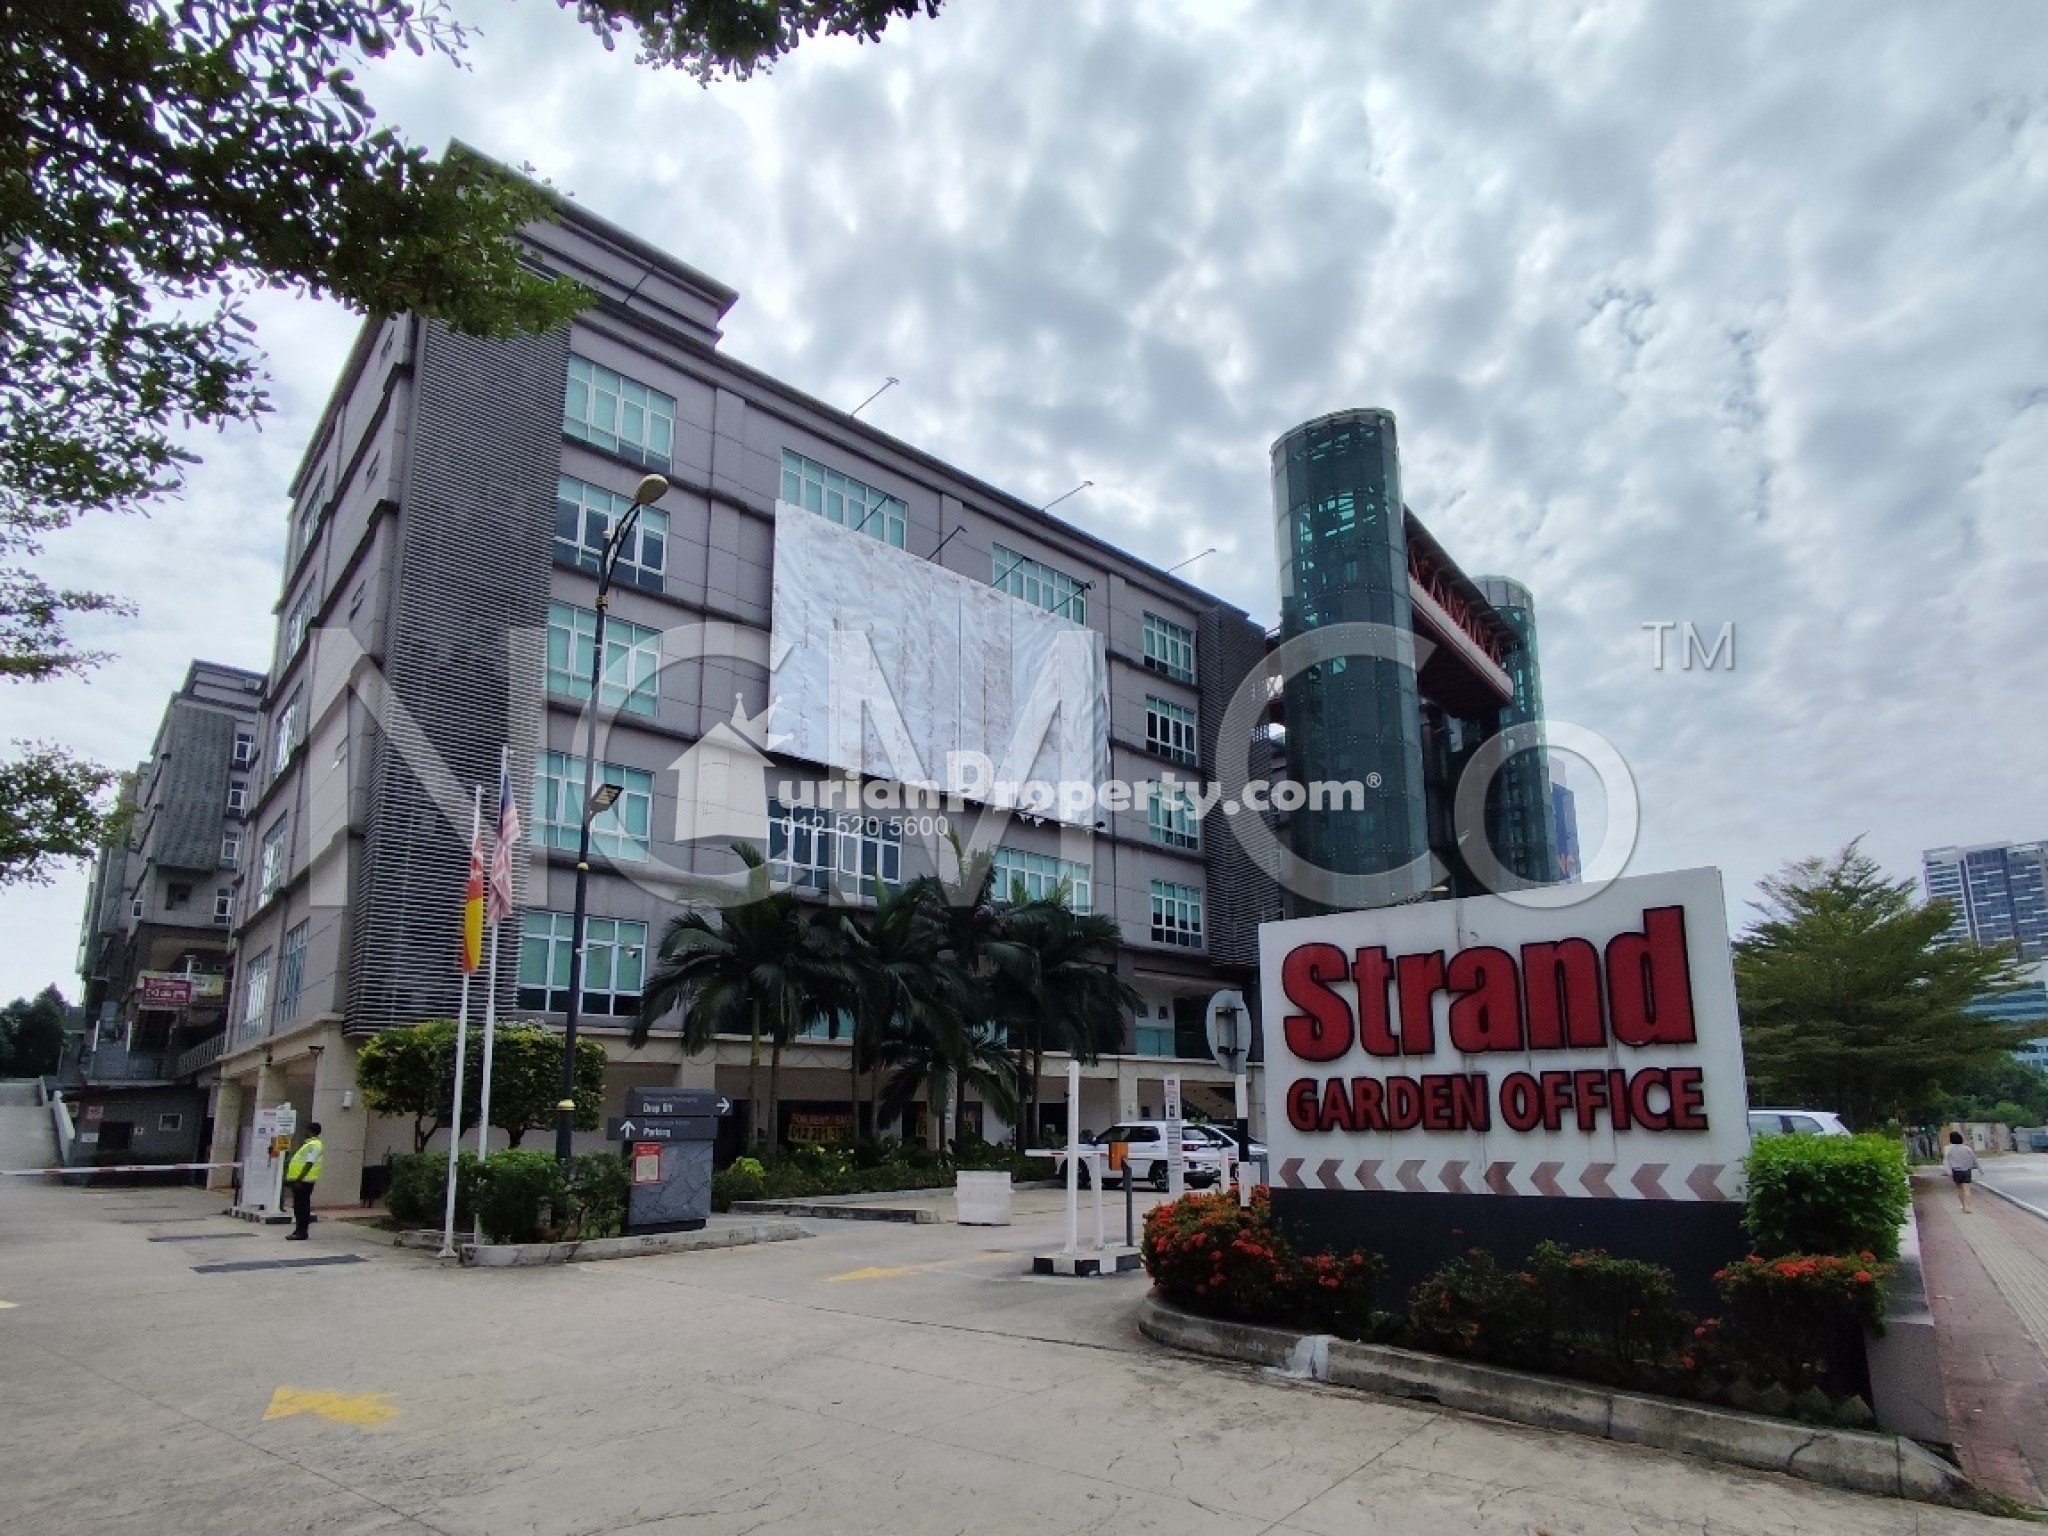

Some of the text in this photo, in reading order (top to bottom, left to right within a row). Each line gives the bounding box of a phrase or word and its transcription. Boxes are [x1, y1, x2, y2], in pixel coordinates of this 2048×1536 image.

[1282, 904, 1698, 1062] Strand
[1286, 1066, 1710, 1132] GARDEN OFFICE
